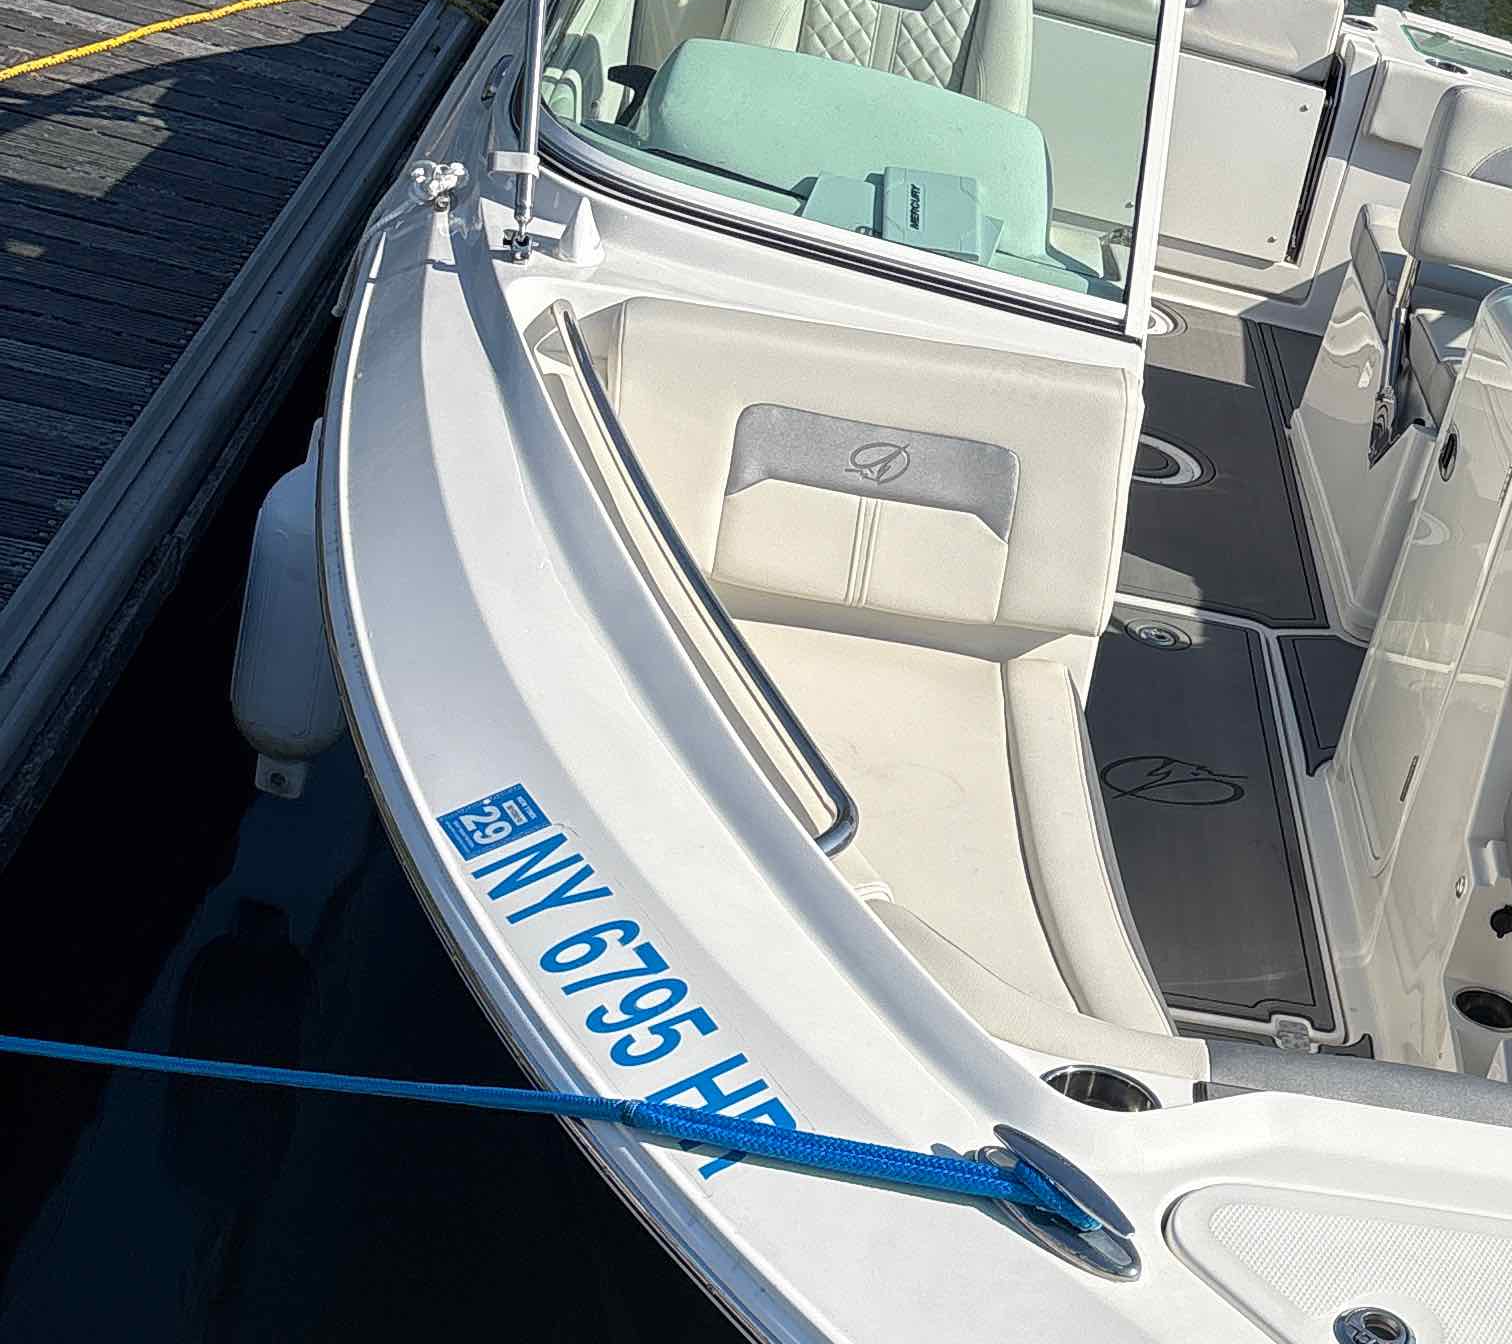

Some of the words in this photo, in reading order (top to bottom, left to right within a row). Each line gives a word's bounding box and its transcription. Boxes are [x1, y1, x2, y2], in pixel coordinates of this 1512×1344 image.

[910, 183, 921, 231] MERCURY
[470, 831, 614, 925] NY
[539, 919, 720, 1068] 6795
